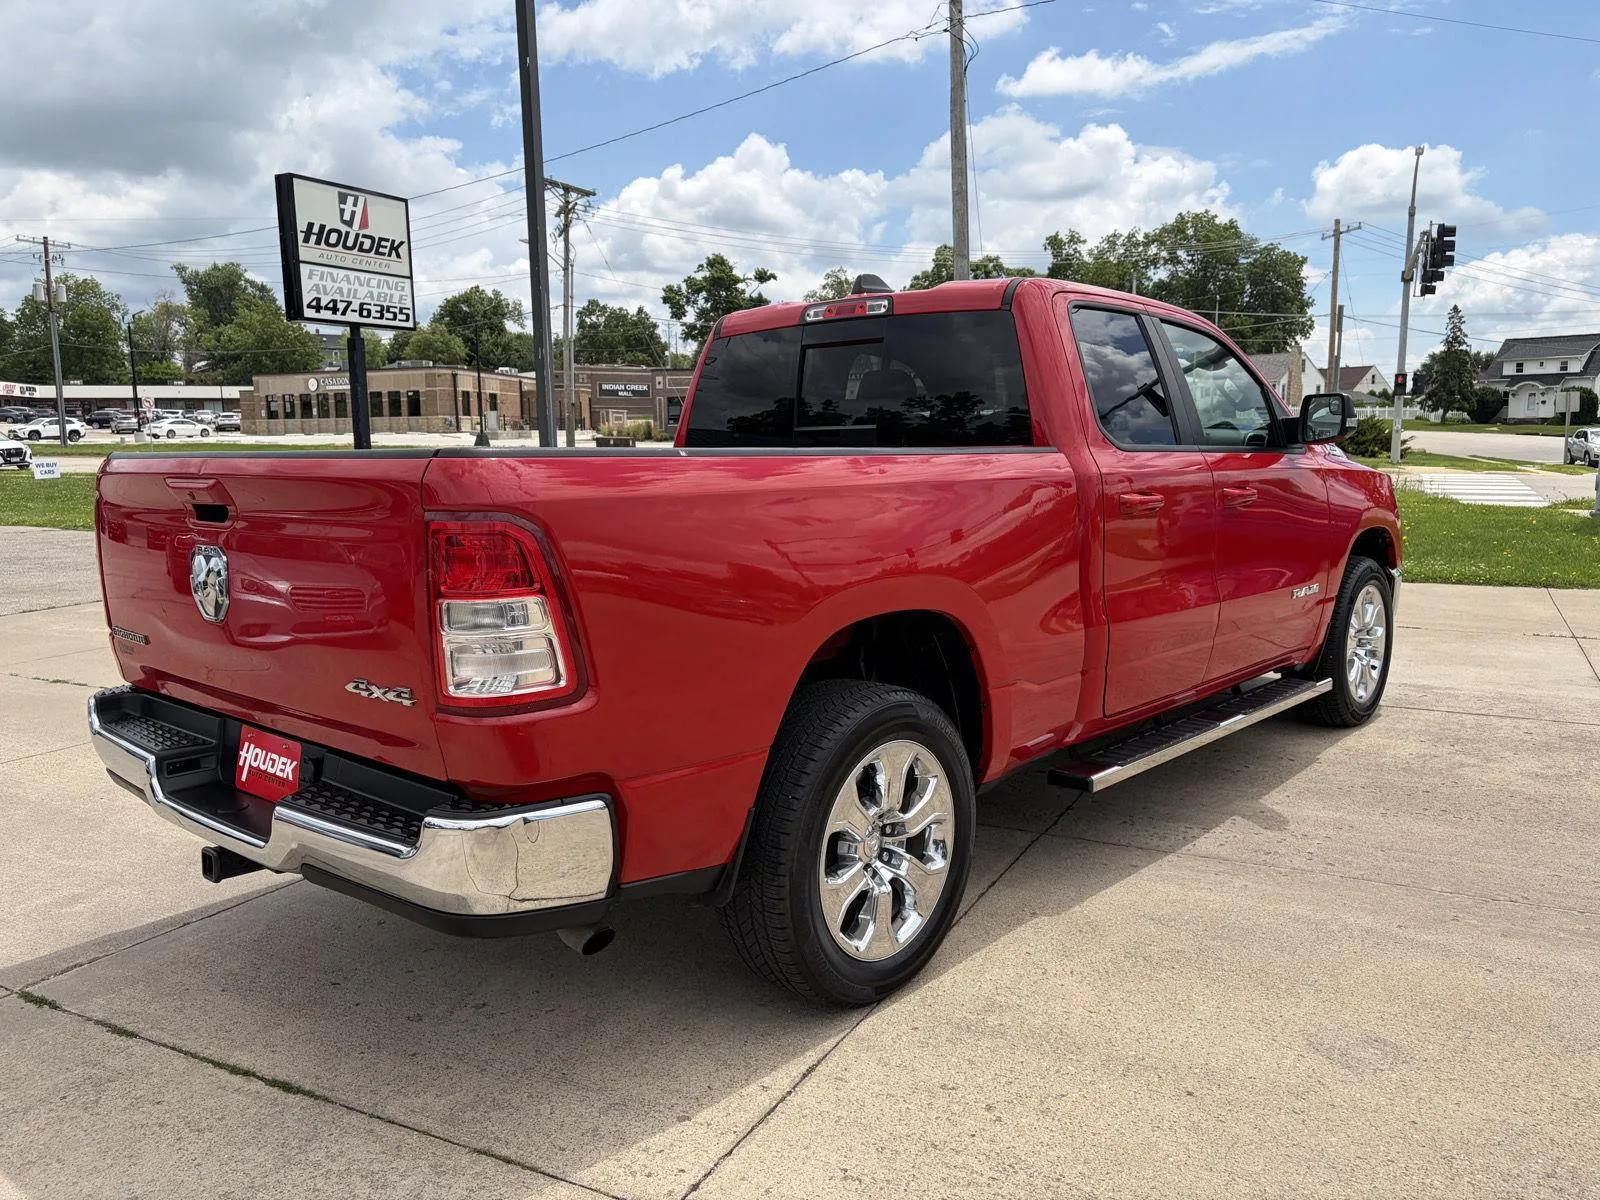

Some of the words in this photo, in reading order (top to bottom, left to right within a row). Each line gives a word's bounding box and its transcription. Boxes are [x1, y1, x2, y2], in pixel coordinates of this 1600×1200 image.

[299, 221, 406, 260] HOUDEK
[318, 252, 347, 263] AUTO
[351, 257, 391, 270] CENTER
[306, 268, 406, 292] FINANCING
[306, 283, 409, 306] AVAILABLE
[306, 296, 411, 323] 447-6355
[1292, 583, 1320, 600] RAM
[238, 741, 299, 782] HOUDEK
[248, 768, 263, 780] AUTO
[264, 774, 287, 789] CENTER
